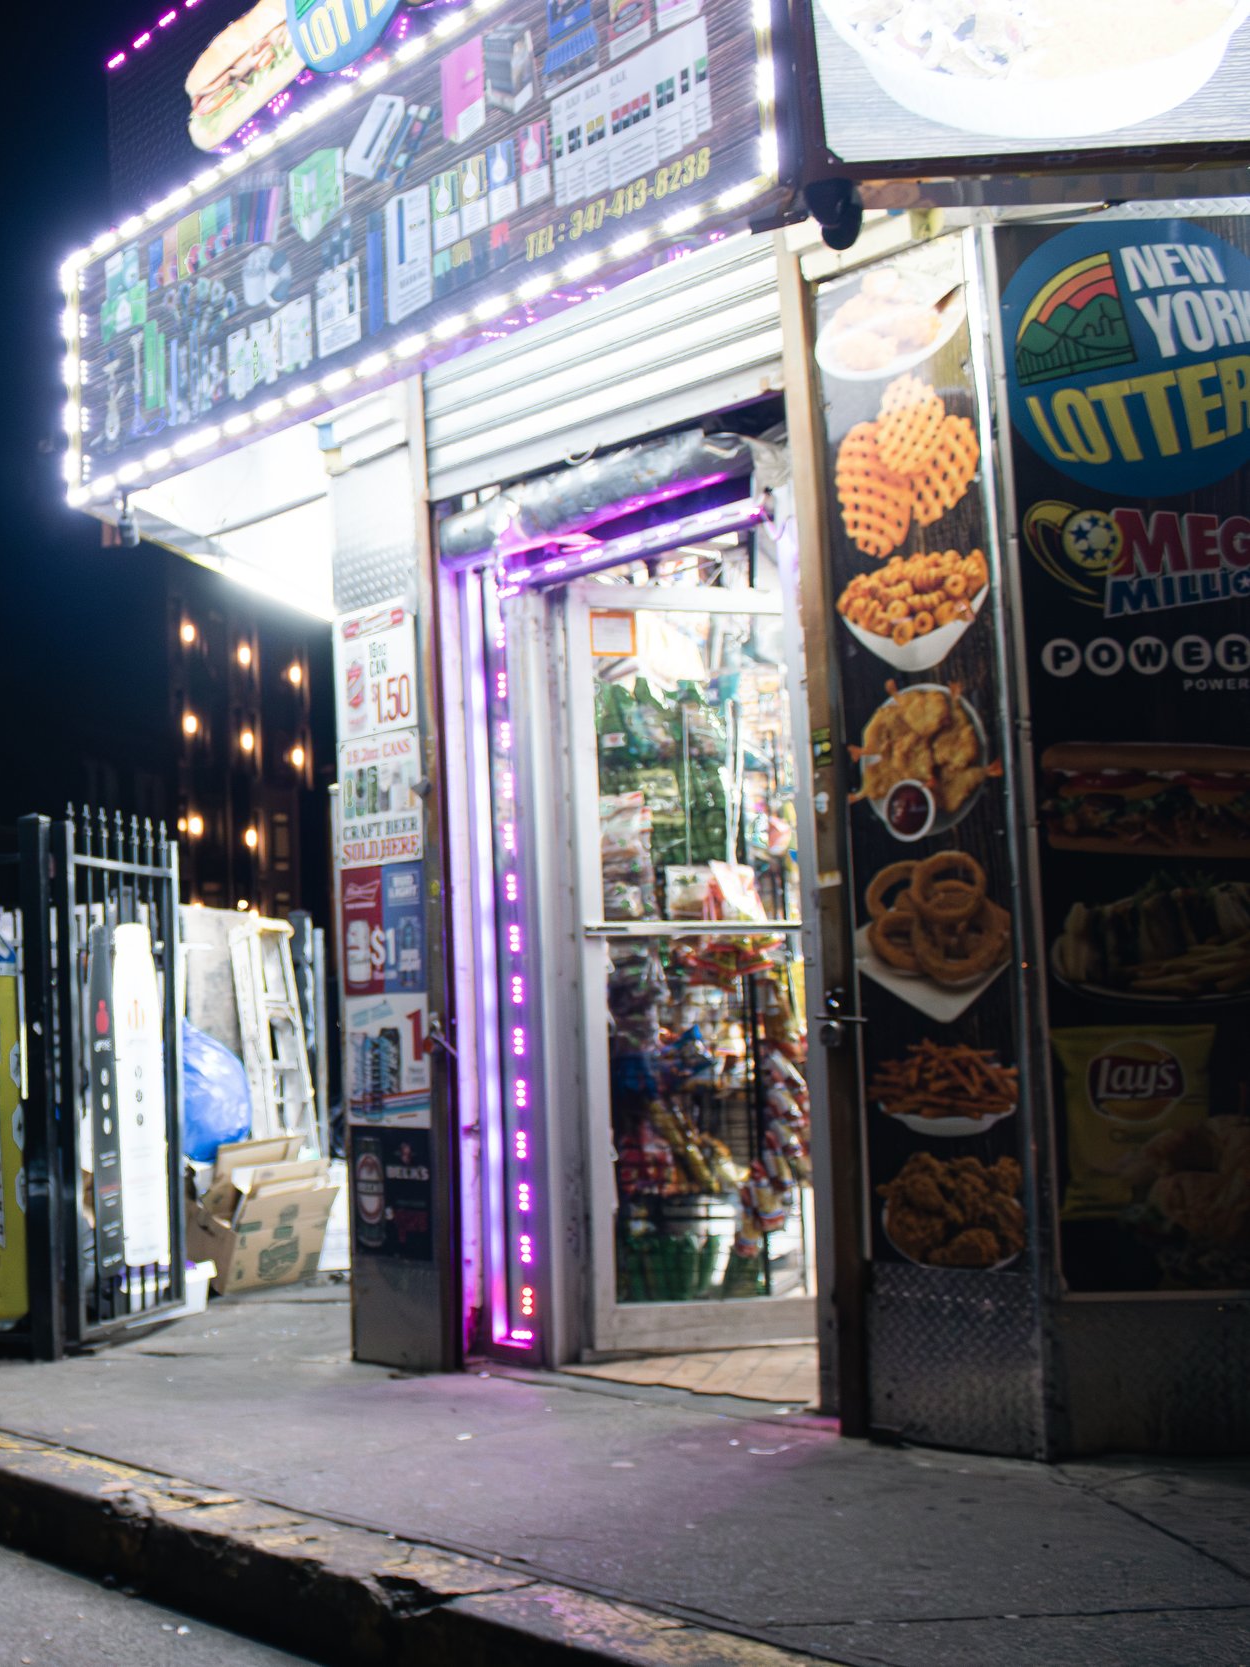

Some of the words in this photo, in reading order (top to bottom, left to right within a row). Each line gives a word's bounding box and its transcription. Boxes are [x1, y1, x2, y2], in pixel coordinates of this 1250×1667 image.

[526, 224, 555, 261] TEL
[569, 146, 712, 240] 347-413-8238
[1119, 243, 1226, 292] NEW
[369, 658, 388, 678] CAN
[371, 672, 411, 724] $1.50
[382, 738, 412, 758] CANS
[343, 821, 382, 841] CRAFT
[385, 816, 418, 836] BEER
[343, 841, 380, 862] SOLD
[380, 834, 419, 858] HERE
[371, 924, 397, 971] $1
[1096, 1058, 1177, 1099] Lay's
[386, 1165, 430, 1181] BECK'S
